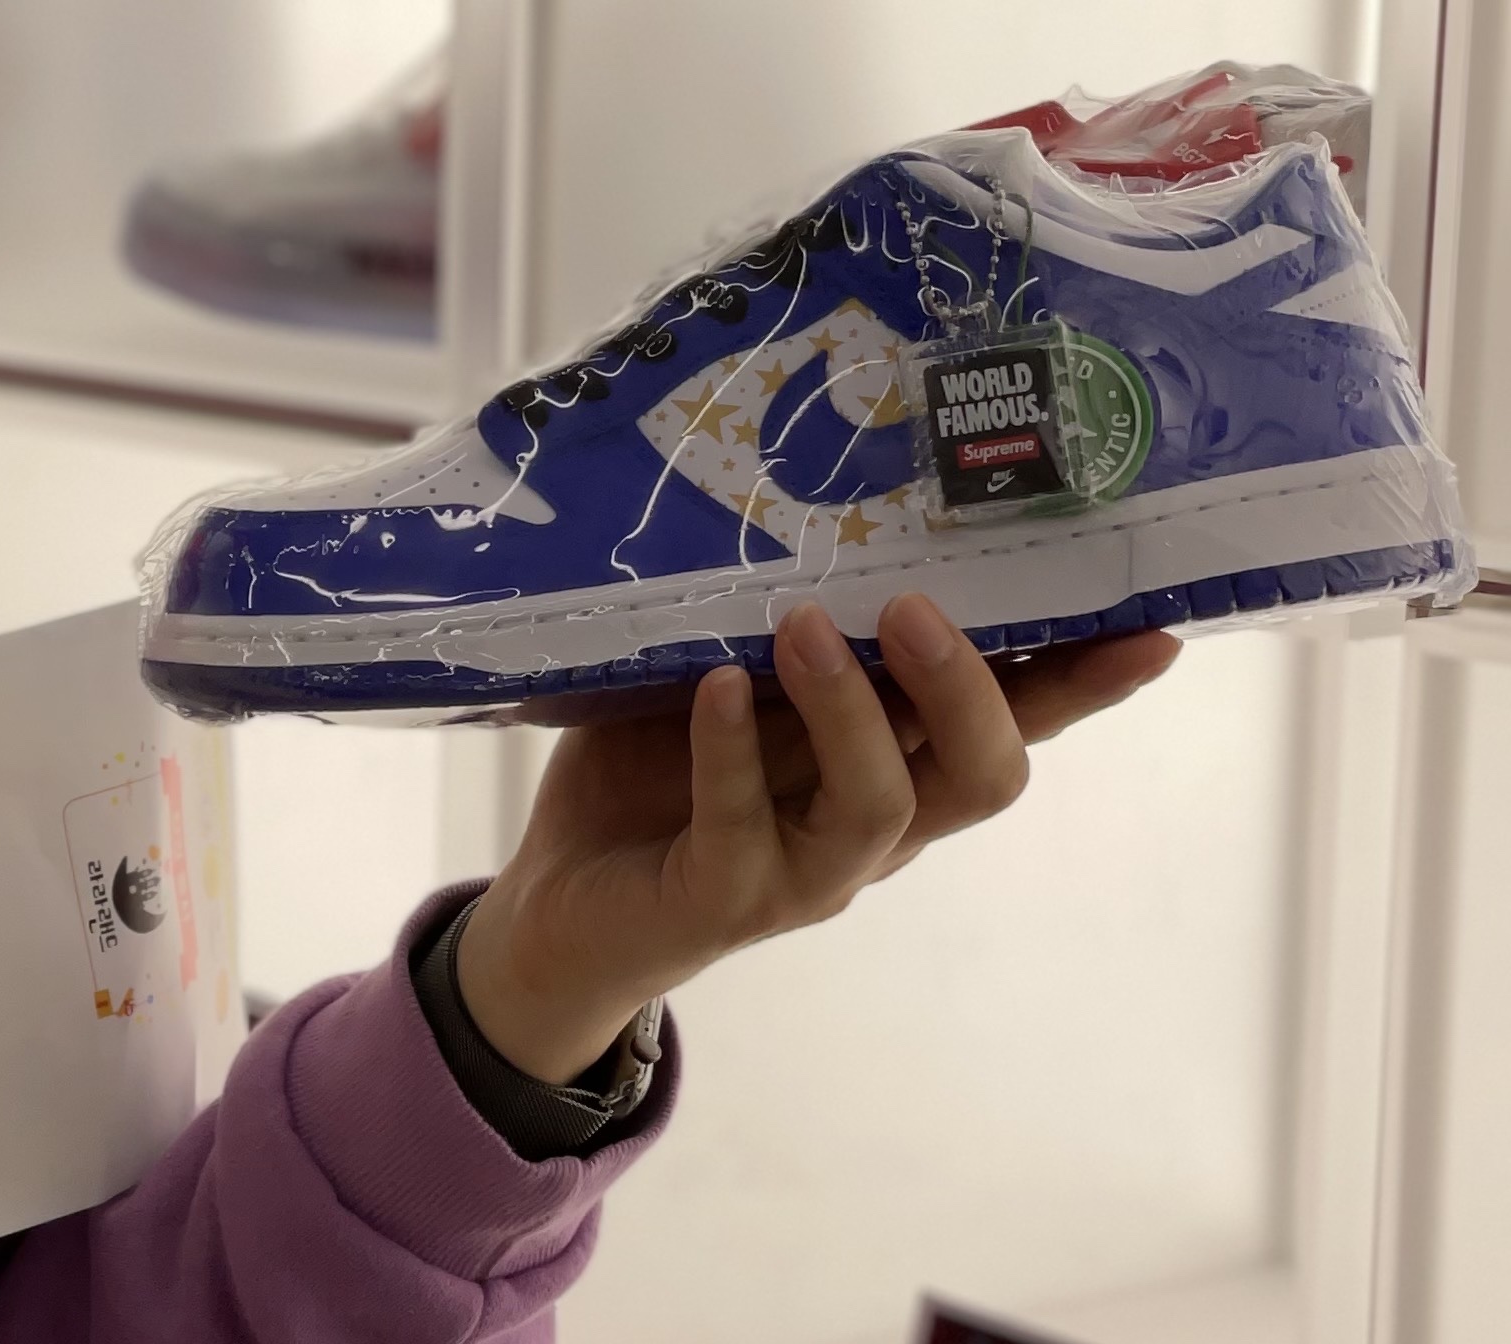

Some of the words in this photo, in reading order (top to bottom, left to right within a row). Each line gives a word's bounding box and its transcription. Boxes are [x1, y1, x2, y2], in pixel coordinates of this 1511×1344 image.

[940, 361, 1033, 404] WORLD
[936, 393, 1049, 438] FAMOUS.
[963, 439, 1035, 464] Supreme
[1080, 412, 1131, 487] ENTIC
[88, 859, 118, 953] 라라랜드
